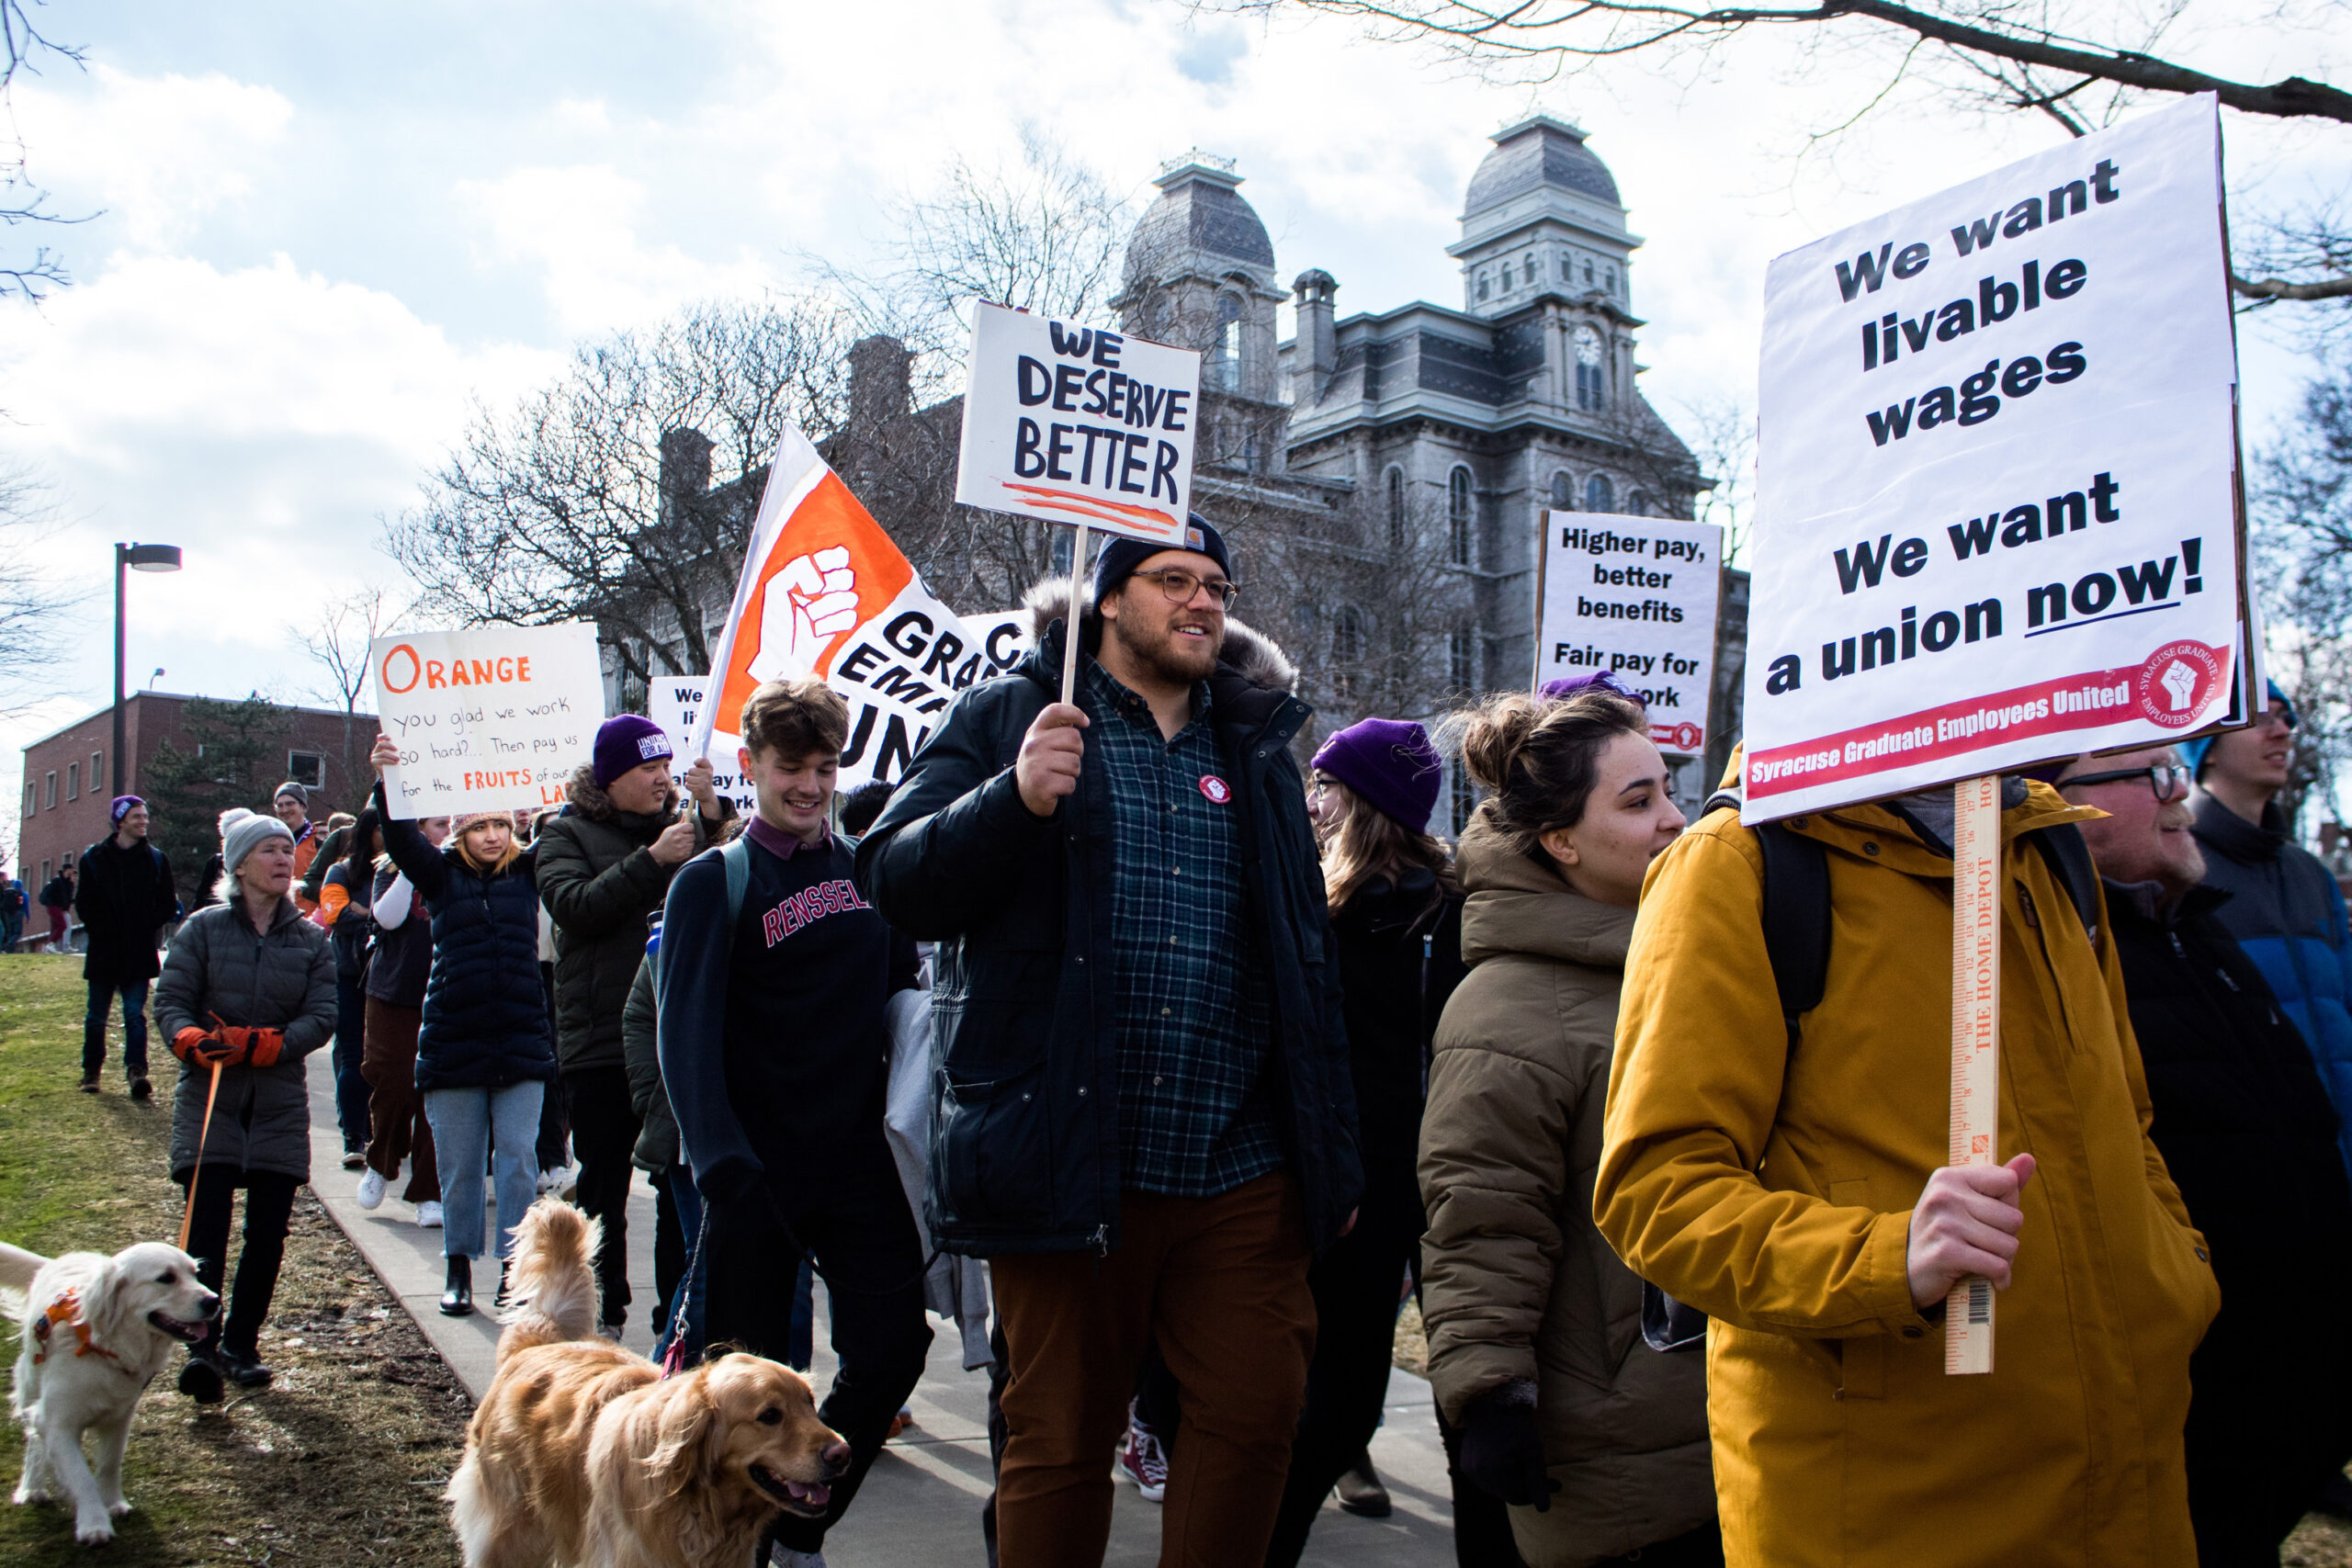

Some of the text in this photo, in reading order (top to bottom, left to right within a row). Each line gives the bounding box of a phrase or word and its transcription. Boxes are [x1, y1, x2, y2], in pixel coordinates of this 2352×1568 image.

[1835, 158, 2120, 303] We want
[1862, 258, 2087, 372] livable
[1049, 321, 1124, 368] WE
[1017, 355, 1191, 432] DESERVE
[1865, 341, 2086, 447] wages
[1014, 417, 1179, 504] BETTER
[1562, 527, 1705, 562] Higher pay,
[1833, 471, 2120, 595] We want
[1593, 563, 1672, 589] better
[1577, 596, 1683, 623] benefits
[1766, 536, 2202, 696] a union now!
[382, 643, 532, 694] ORANGE
[883, 611, 998, 692] GRA
[1554, 643, 1699, 676] Fair pay for
[2140, 645, 2219, 690] SYRACUSE GRADUATE
[393, 696, 571, 738] you glad we work
[674, 689, 703, 703] We
[1634, 686, 1680, 707] ork
[2142, 683, 2216, 725] EMPLOYEES UNITED
[683, 711, 697, 725] li
[1750, 681, 2131, 784] Syracuse Graduate Employees United
[400, 749, 419, 766] so
[490, 737, 525, 754] Then
[534, 739, 558, 753] pay
[565, 735, 579, 746] us
[641, 745, 656, 757] FOR
[402, 767, 570, 797] for the FRUITS of our
[540, 783, 571, 805] LA
[712, 775, 733, 789] ay
[735, 795, 754, 808] rk
[1978, 856, 1993, 928] DEPOT
[1977, 933, 1992, 1000] HOME
[1976, 1007, 1991, 1054] THE
